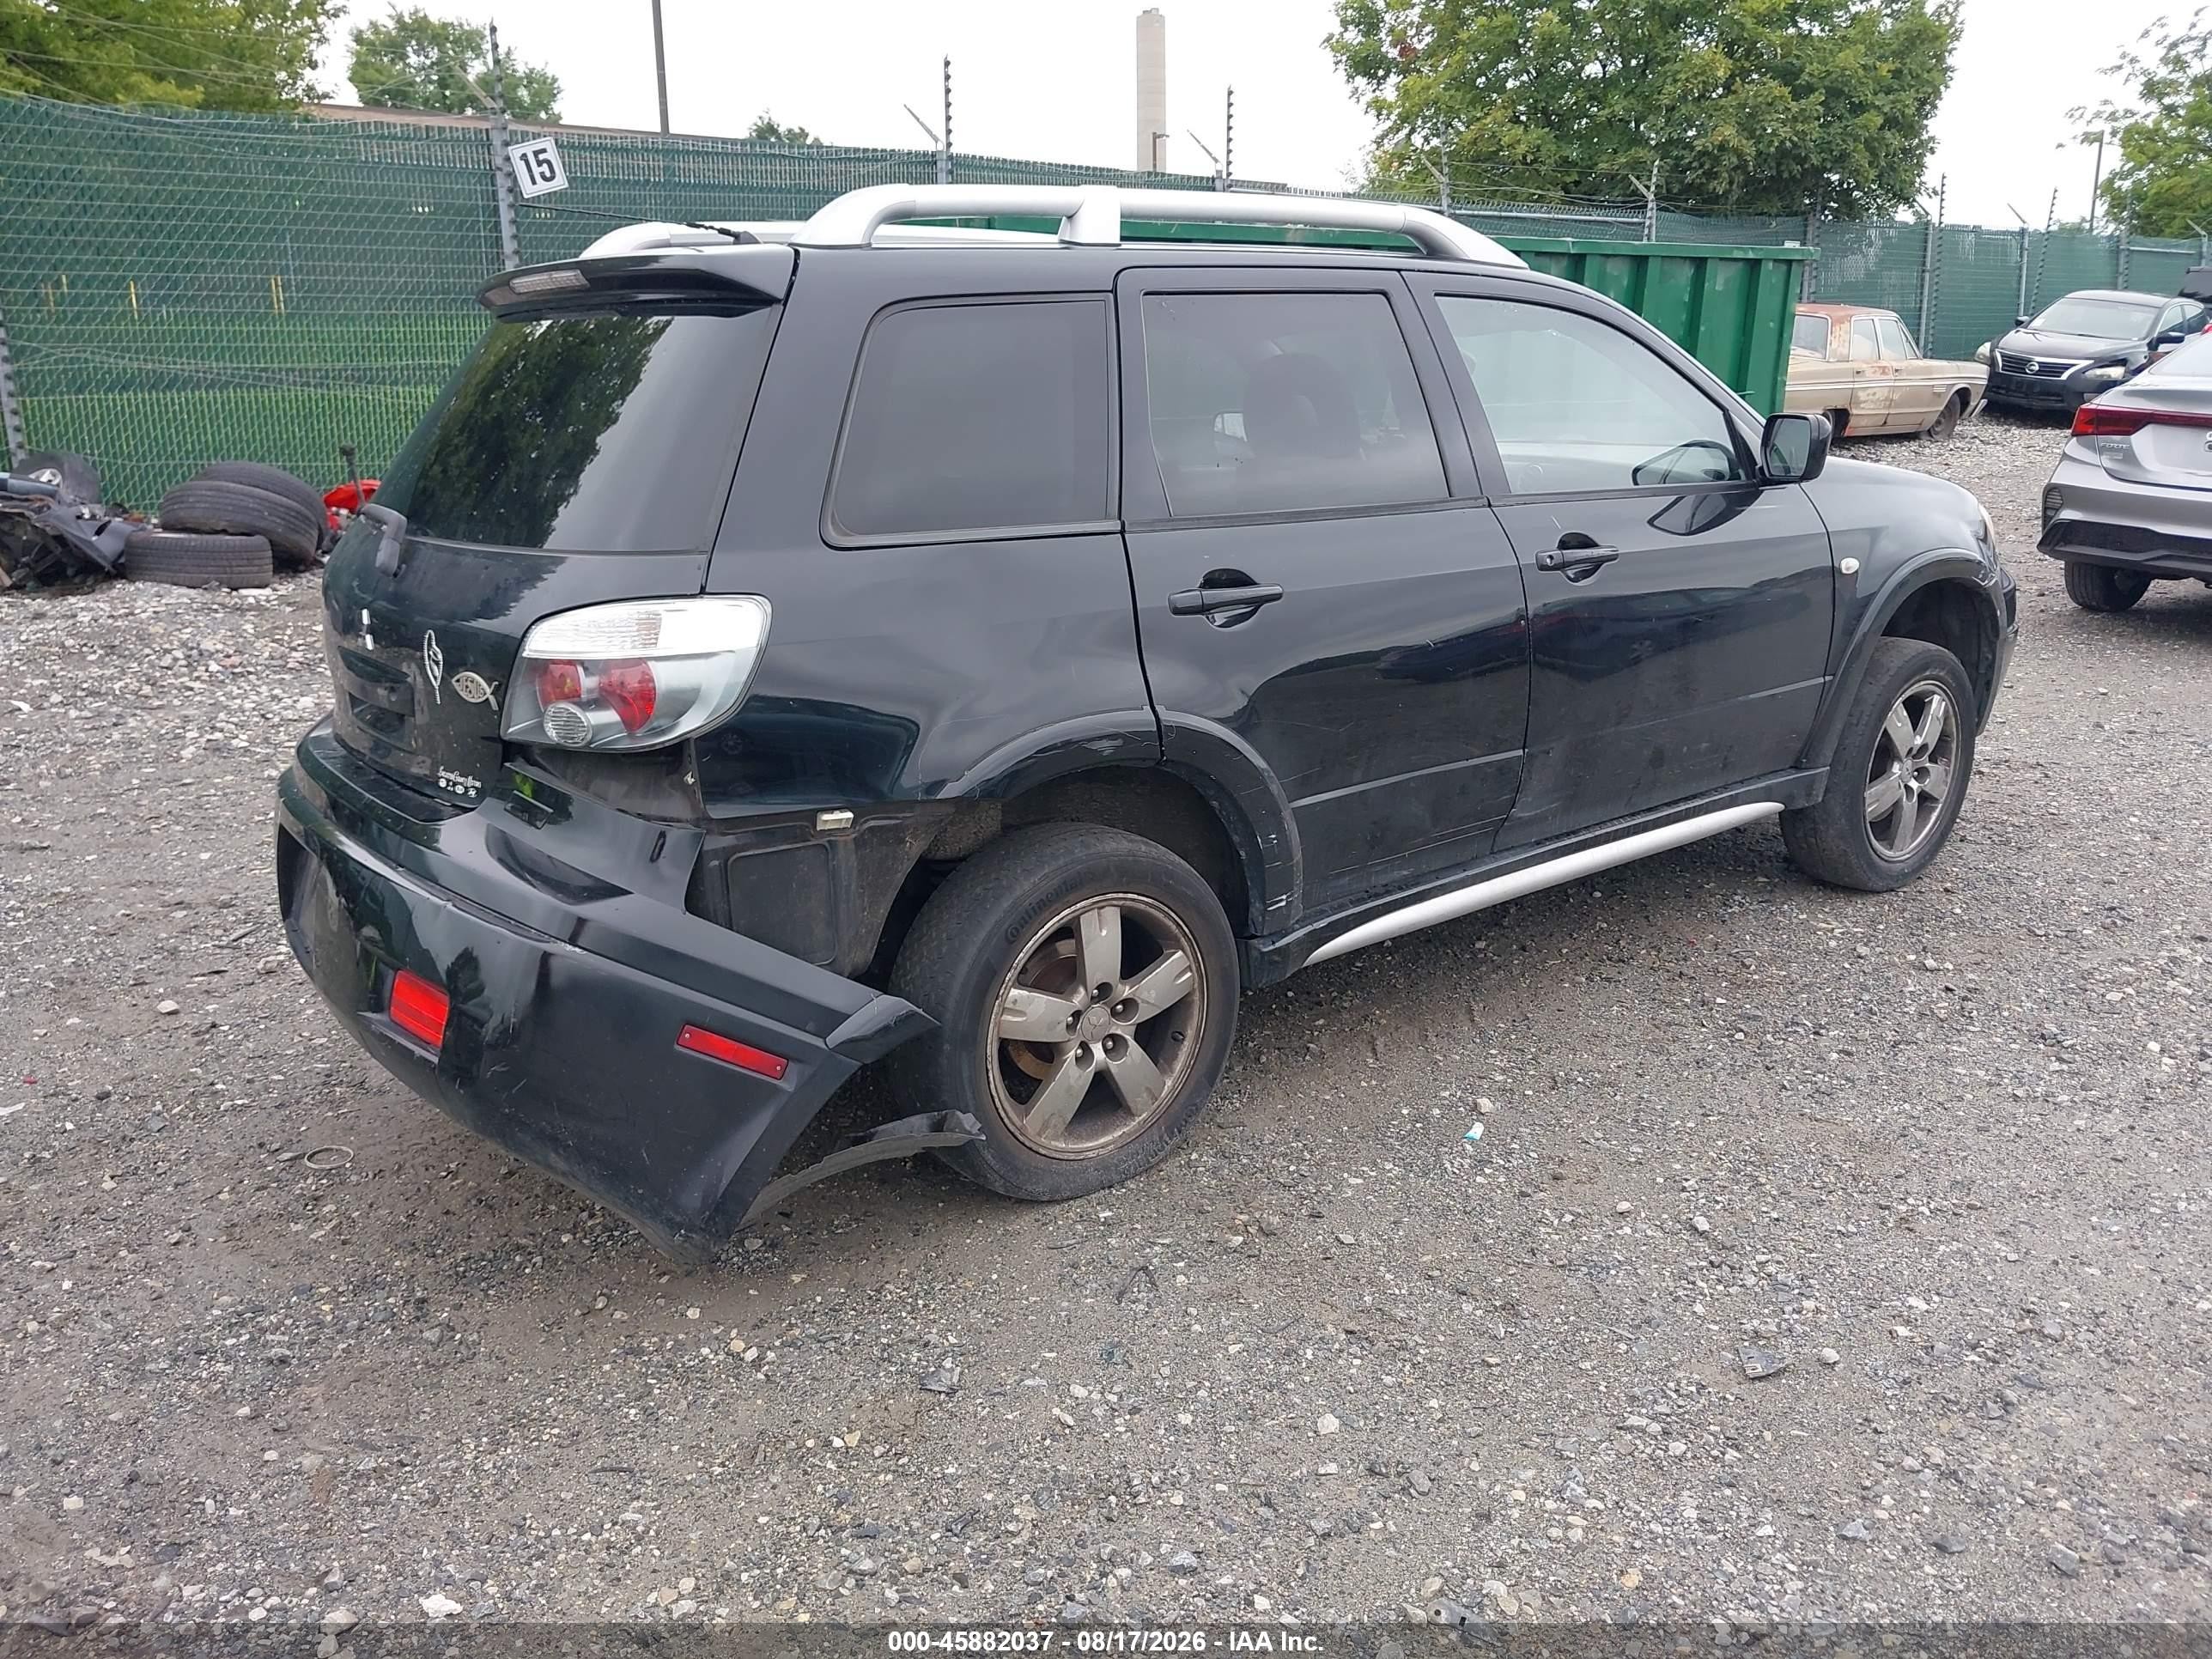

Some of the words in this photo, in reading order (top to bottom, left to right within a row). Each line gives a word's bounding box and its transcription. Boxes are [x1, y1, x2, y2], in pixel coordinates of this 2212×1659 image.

[519, 148, 556, 186] 15
[2100, 442, 2131, 451] FORTE
[457, 676, 485, 700] JESUS
